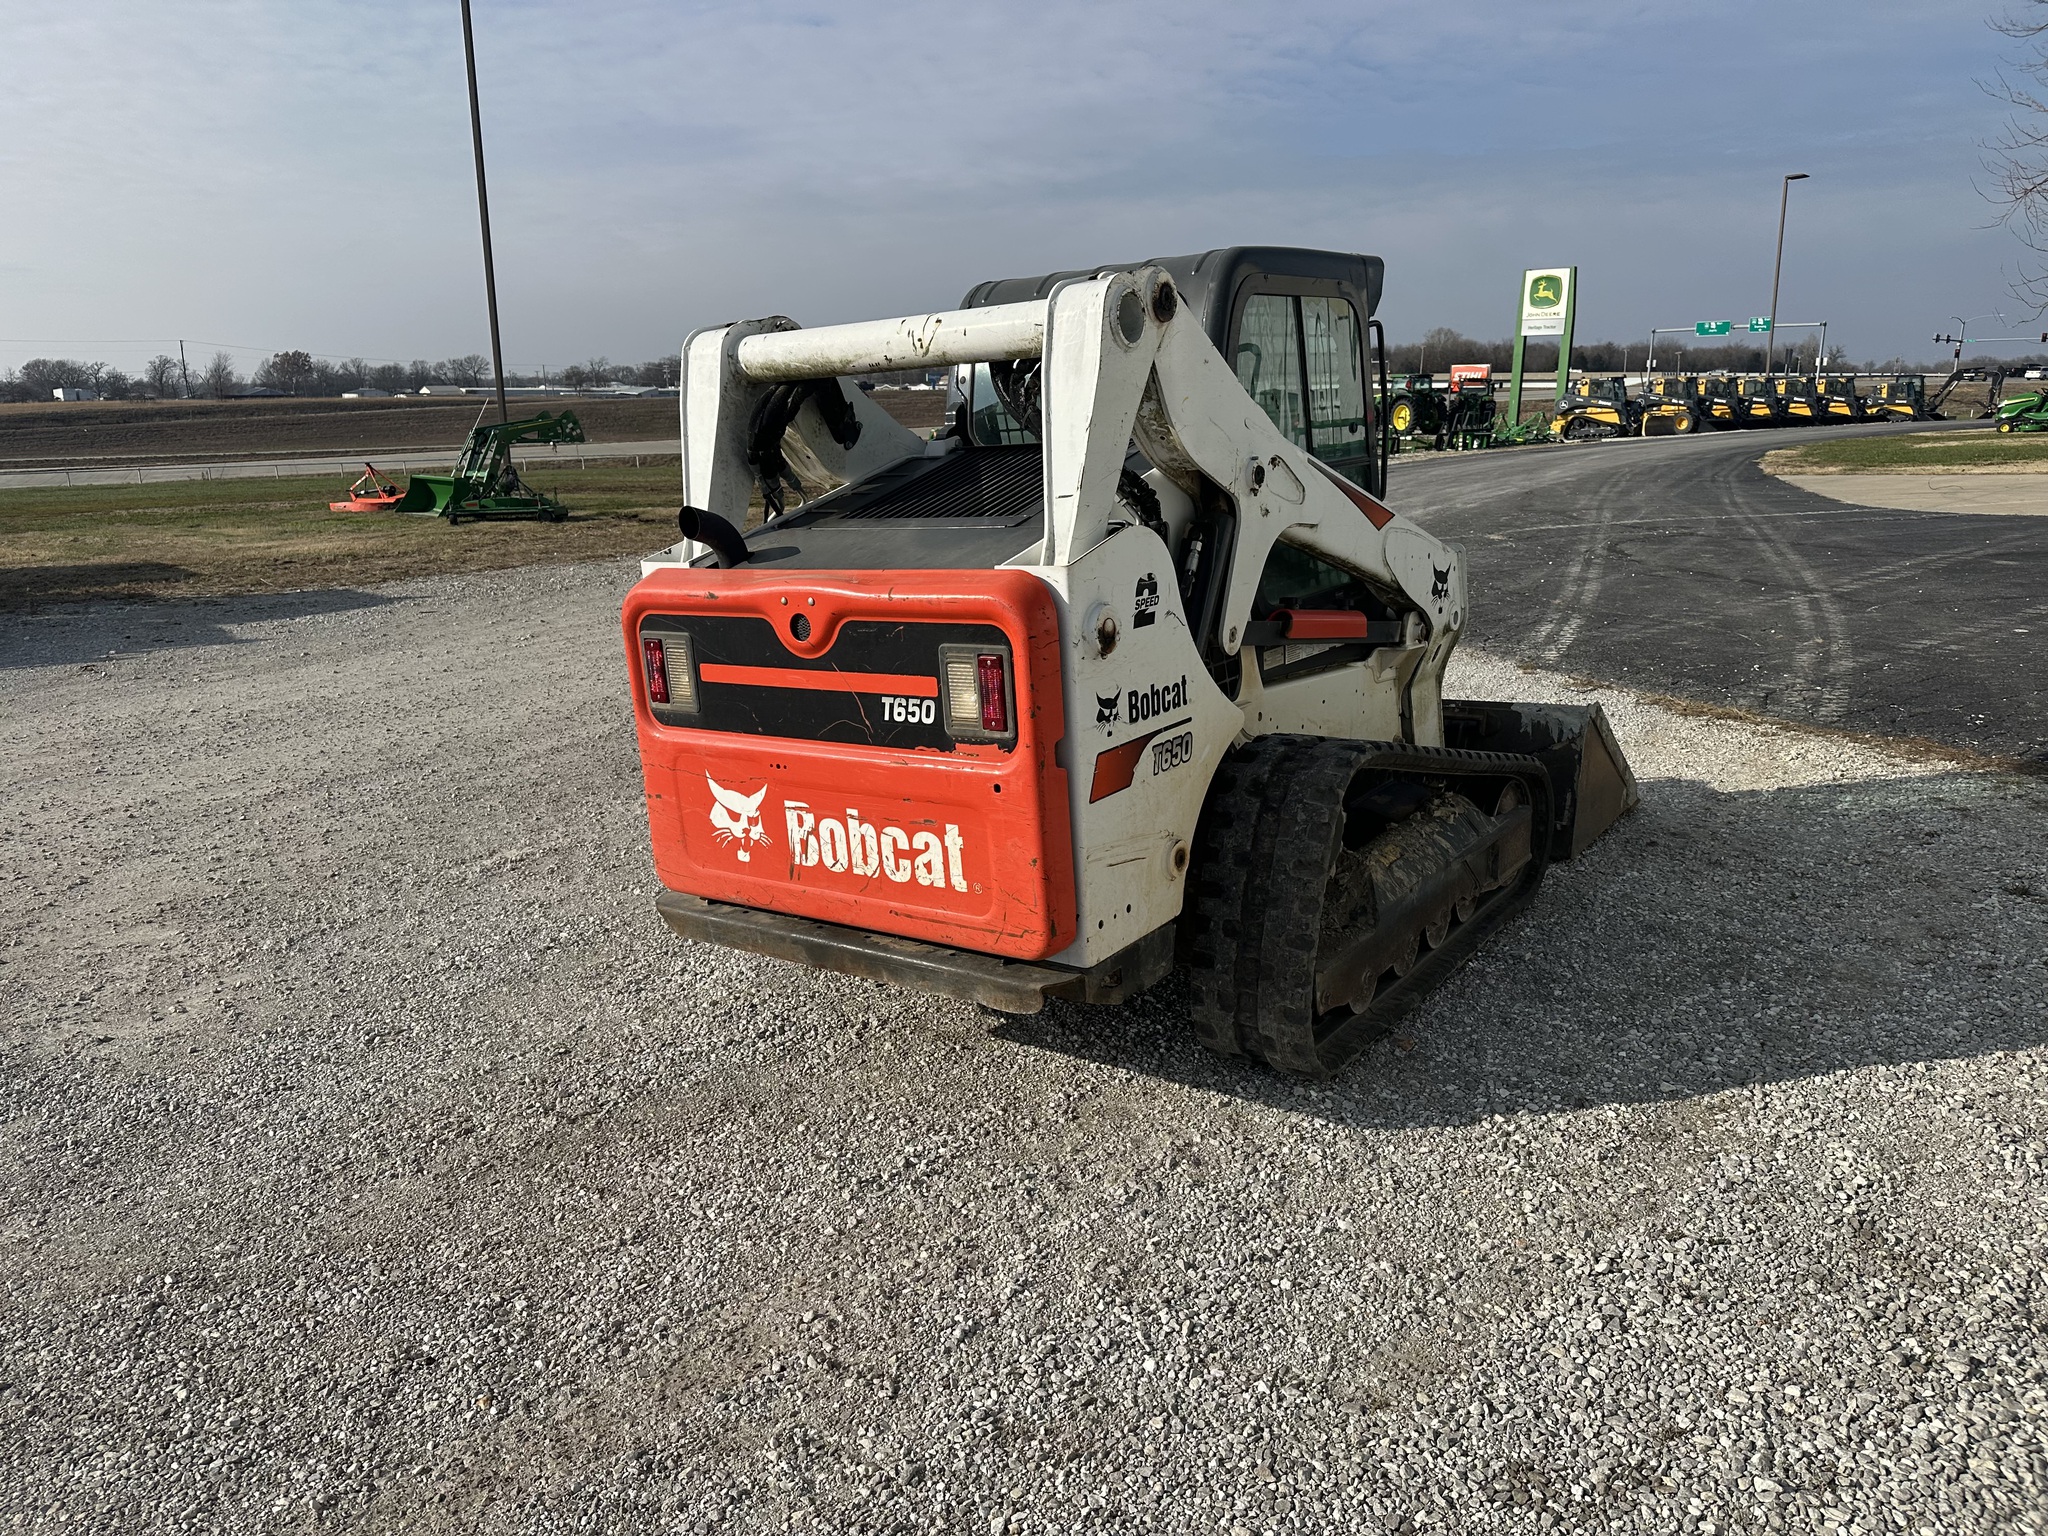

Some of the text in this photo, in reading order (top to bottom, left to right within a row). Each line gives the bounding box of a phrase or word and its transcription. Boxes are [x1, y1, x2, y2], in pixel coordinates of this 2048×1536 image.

[1454, 371, 1482, 381] STIHL
[1134, 594, 1160, 610] SPEED
[882, 696, 936, 725] T650
[1128, 675, 1187, 724] Bobcat
[1152, 731, 1193, 776] T650
[783, 800, 969, 893] Bobcat
